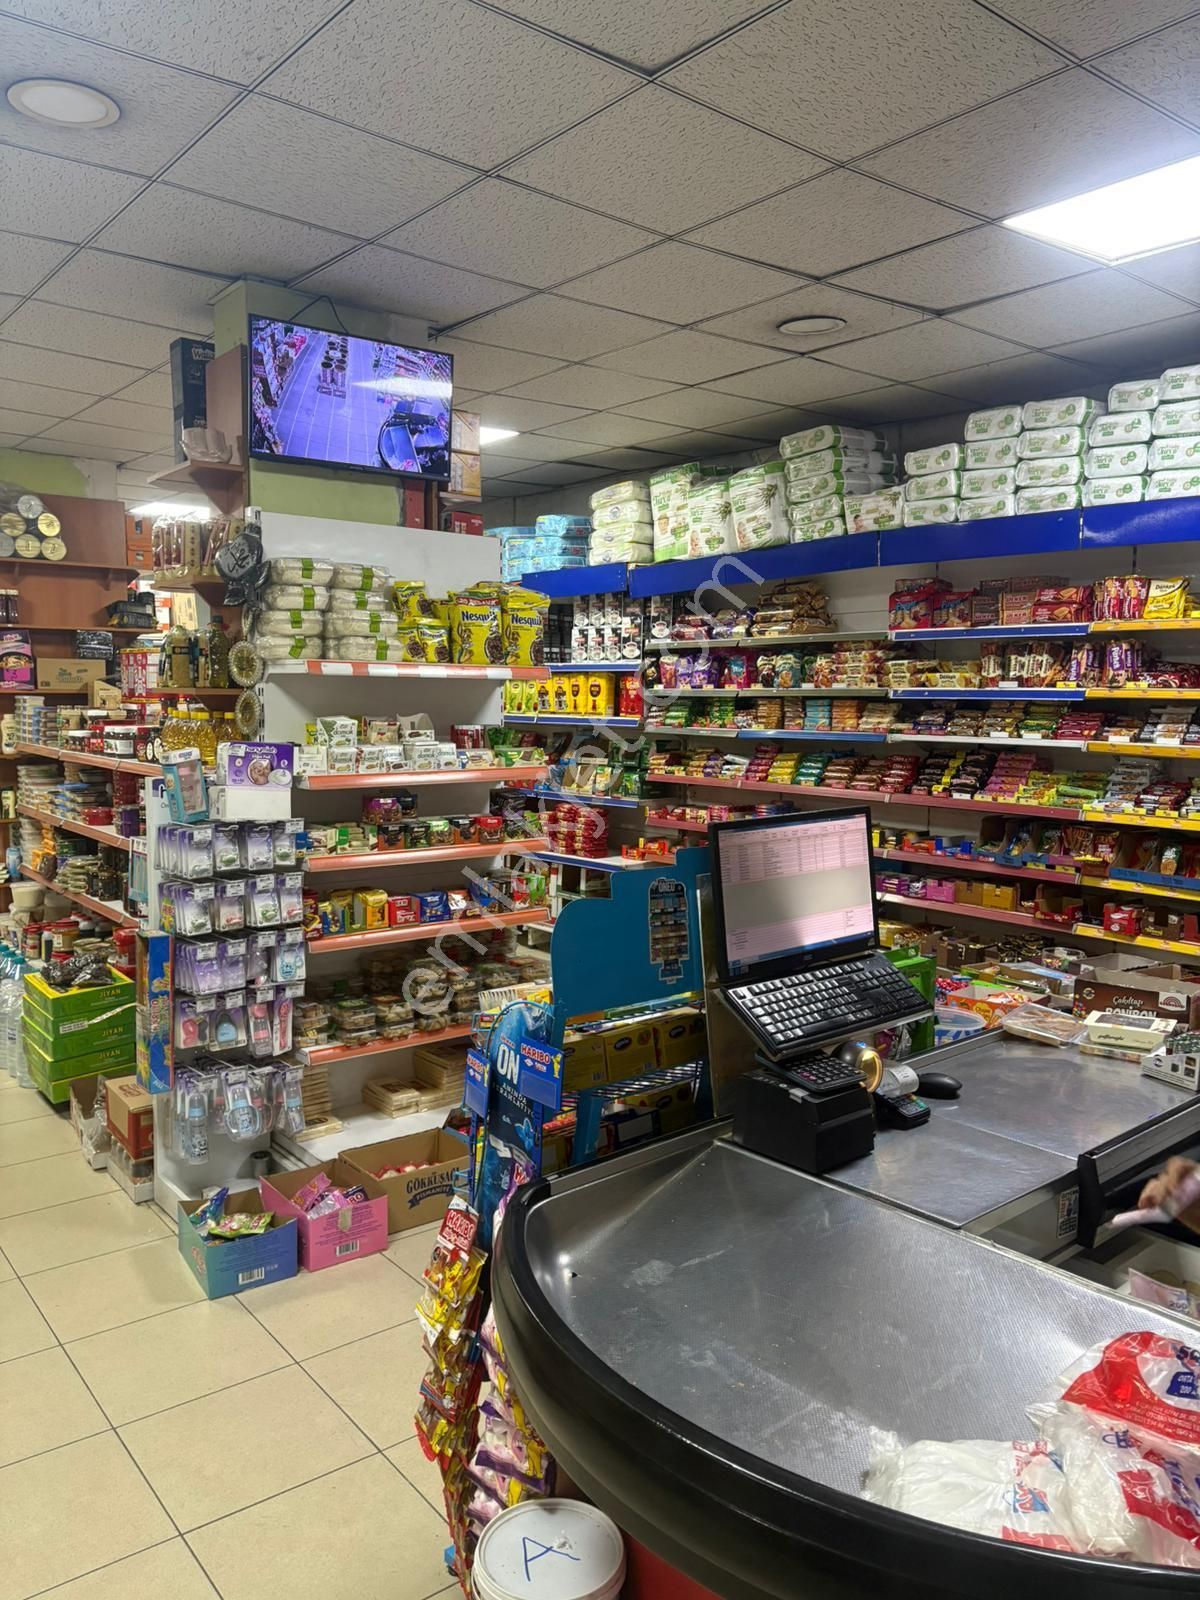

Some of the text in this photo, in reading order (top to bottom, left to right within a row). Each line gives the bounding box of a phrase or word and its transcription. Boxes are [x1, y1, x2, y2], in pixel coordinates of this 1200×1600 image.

[461, 610, 498, 623] Nesquik
[520, 1042, 551, 1065] HARIBO
[521, 1536, 582, 1583] A
